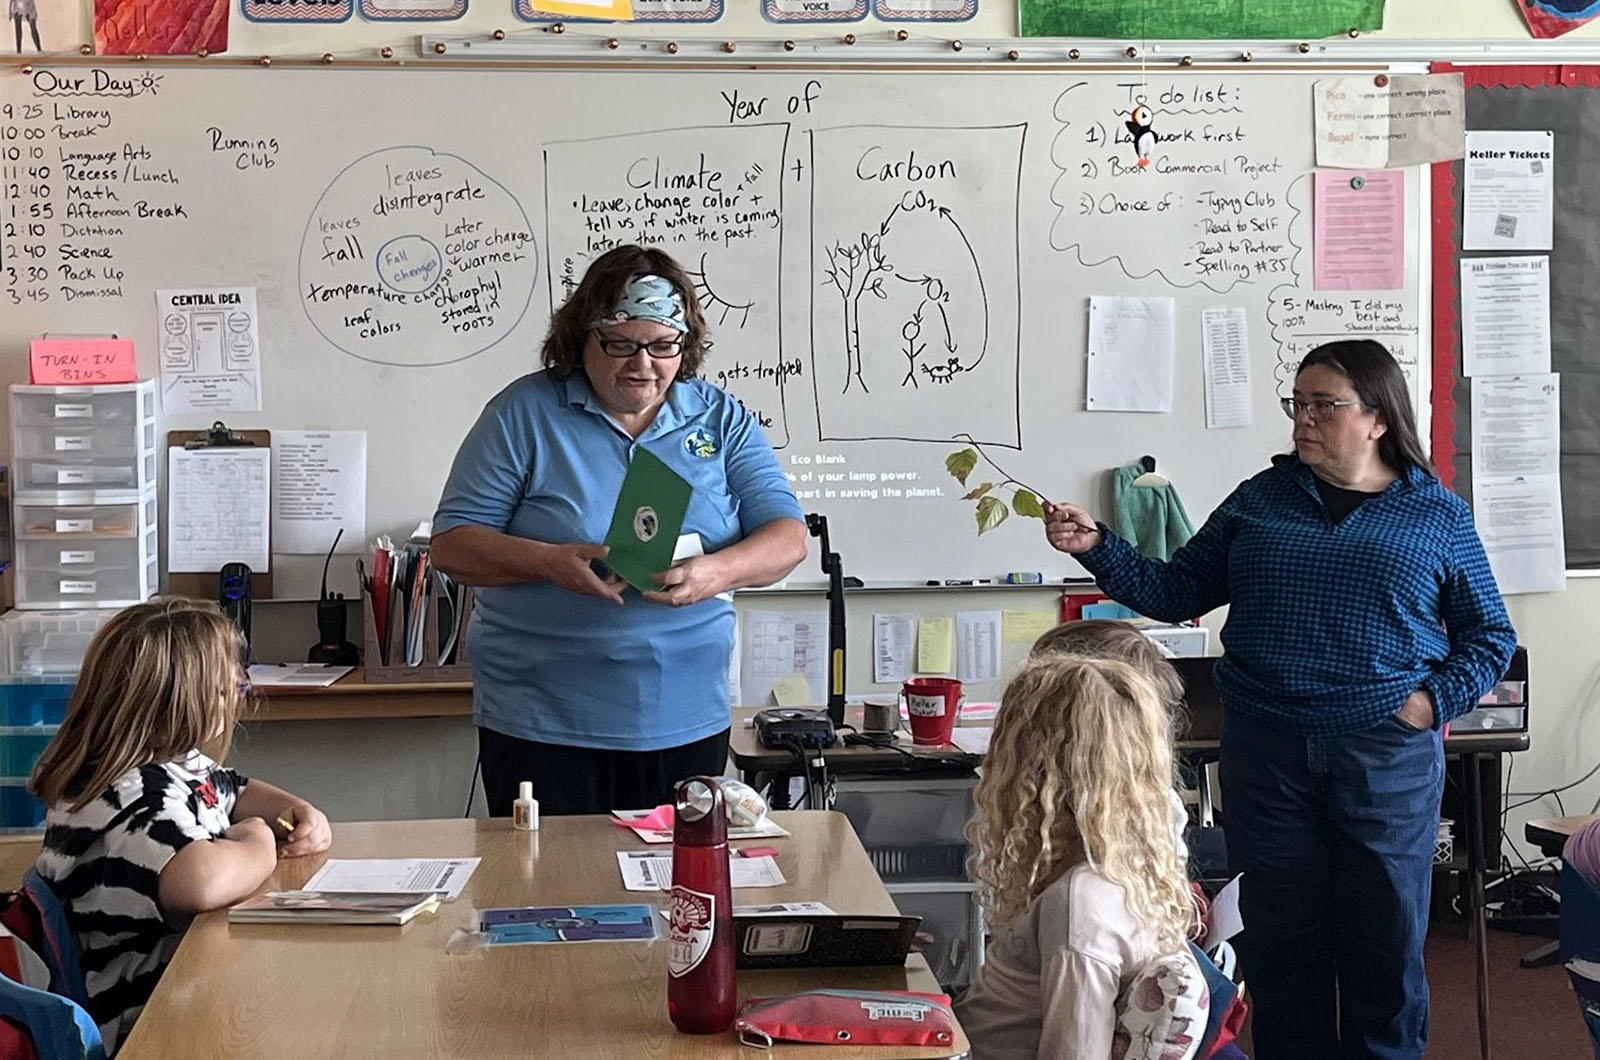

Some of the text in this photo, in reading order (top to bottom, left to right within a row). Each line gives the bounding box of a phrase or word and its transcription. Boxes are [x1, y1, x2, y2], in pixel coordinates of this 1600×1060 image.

[803, 3, 829, 11] VOICE
[34, 70, 134, 96] Our Day
[721, 81, 821, 123] Year of
[1117, 83, 1240, 104] To do list:
[2, 103, 111, 127] 9:25 Library
[52, 126, 97, 140] Break
[206, 127, 279, 153] Running
[1202, 125, 1247, 141] first
[59, 147, 117, 166] Language
[123, 143, 152, 161] Arts
[235, 153, 275, 170] Club
[857, 146, 956, 181] Carbon
[626, 153, 722, 192] Climate
[744, 163, 763, 184] fall
[1156, 155, 1226, 174] Commercial
[385, 164, 442, 189] leaves
[67, 184, 119, 200] Math
[66, 202, 130, 218] Afternoon
[134, 201, 188, 219] Break
[635, 192, 691, 216] change
[703, 192, 740, 208] color
[1099, 193, 1150, 214] Choice
[1245, 191, 1275, 207] Club
[319, 217, 361, 233] leaves
[445, 217, 483, 238] Later
[585, 209, 780, 231] tell us if winter is coming
[1237, 219, 1247, 232] to
[60, 223, 123, 237] Dictation
[445, 227, 533, 255] color change
[587, 236, 622, 251] later
[636, 231, 664, 245] than
[673, 234, 685, 242] in
[696, 228, 719, 242] the
[1228, 241, 1240, 253] to
[59, 246, 113, 259] Science
[322, 234, 364, 267] fall
[385, 250, 408, 267] Fall
[393, 259, 437, 282] changes
[459, 251, 525, 272] warmer
[1255, 258, 1288, 274] #35
[58, 265, 96, 281] Pack
[104, 266, 124, 281] Up
[60, 287, 123, 300] Dismissal
[307, 268, 454, 305] temperature change
[172, 293, 241, 306] CENTRAL IDEA
[1365, 299, 1381, 310] did
[1385, 302, 1402, 312] my
[441, 295, 500, 324] stored in
[1356, 311, 1381, 321] best
[360, 321, 401, 339] colors
[59, 370, 107, 379] BINS
[718, 362, 749, 390] gets
[791, 455, 846, 464] Eco Blank
[801, 472, 813, 481] of
[818, 473, 845, 482] your
[850, 472, 876, 482] lamp
[881, 472, 921, 481] power.
[797, 487, 944, 499] part in saving the planet.
